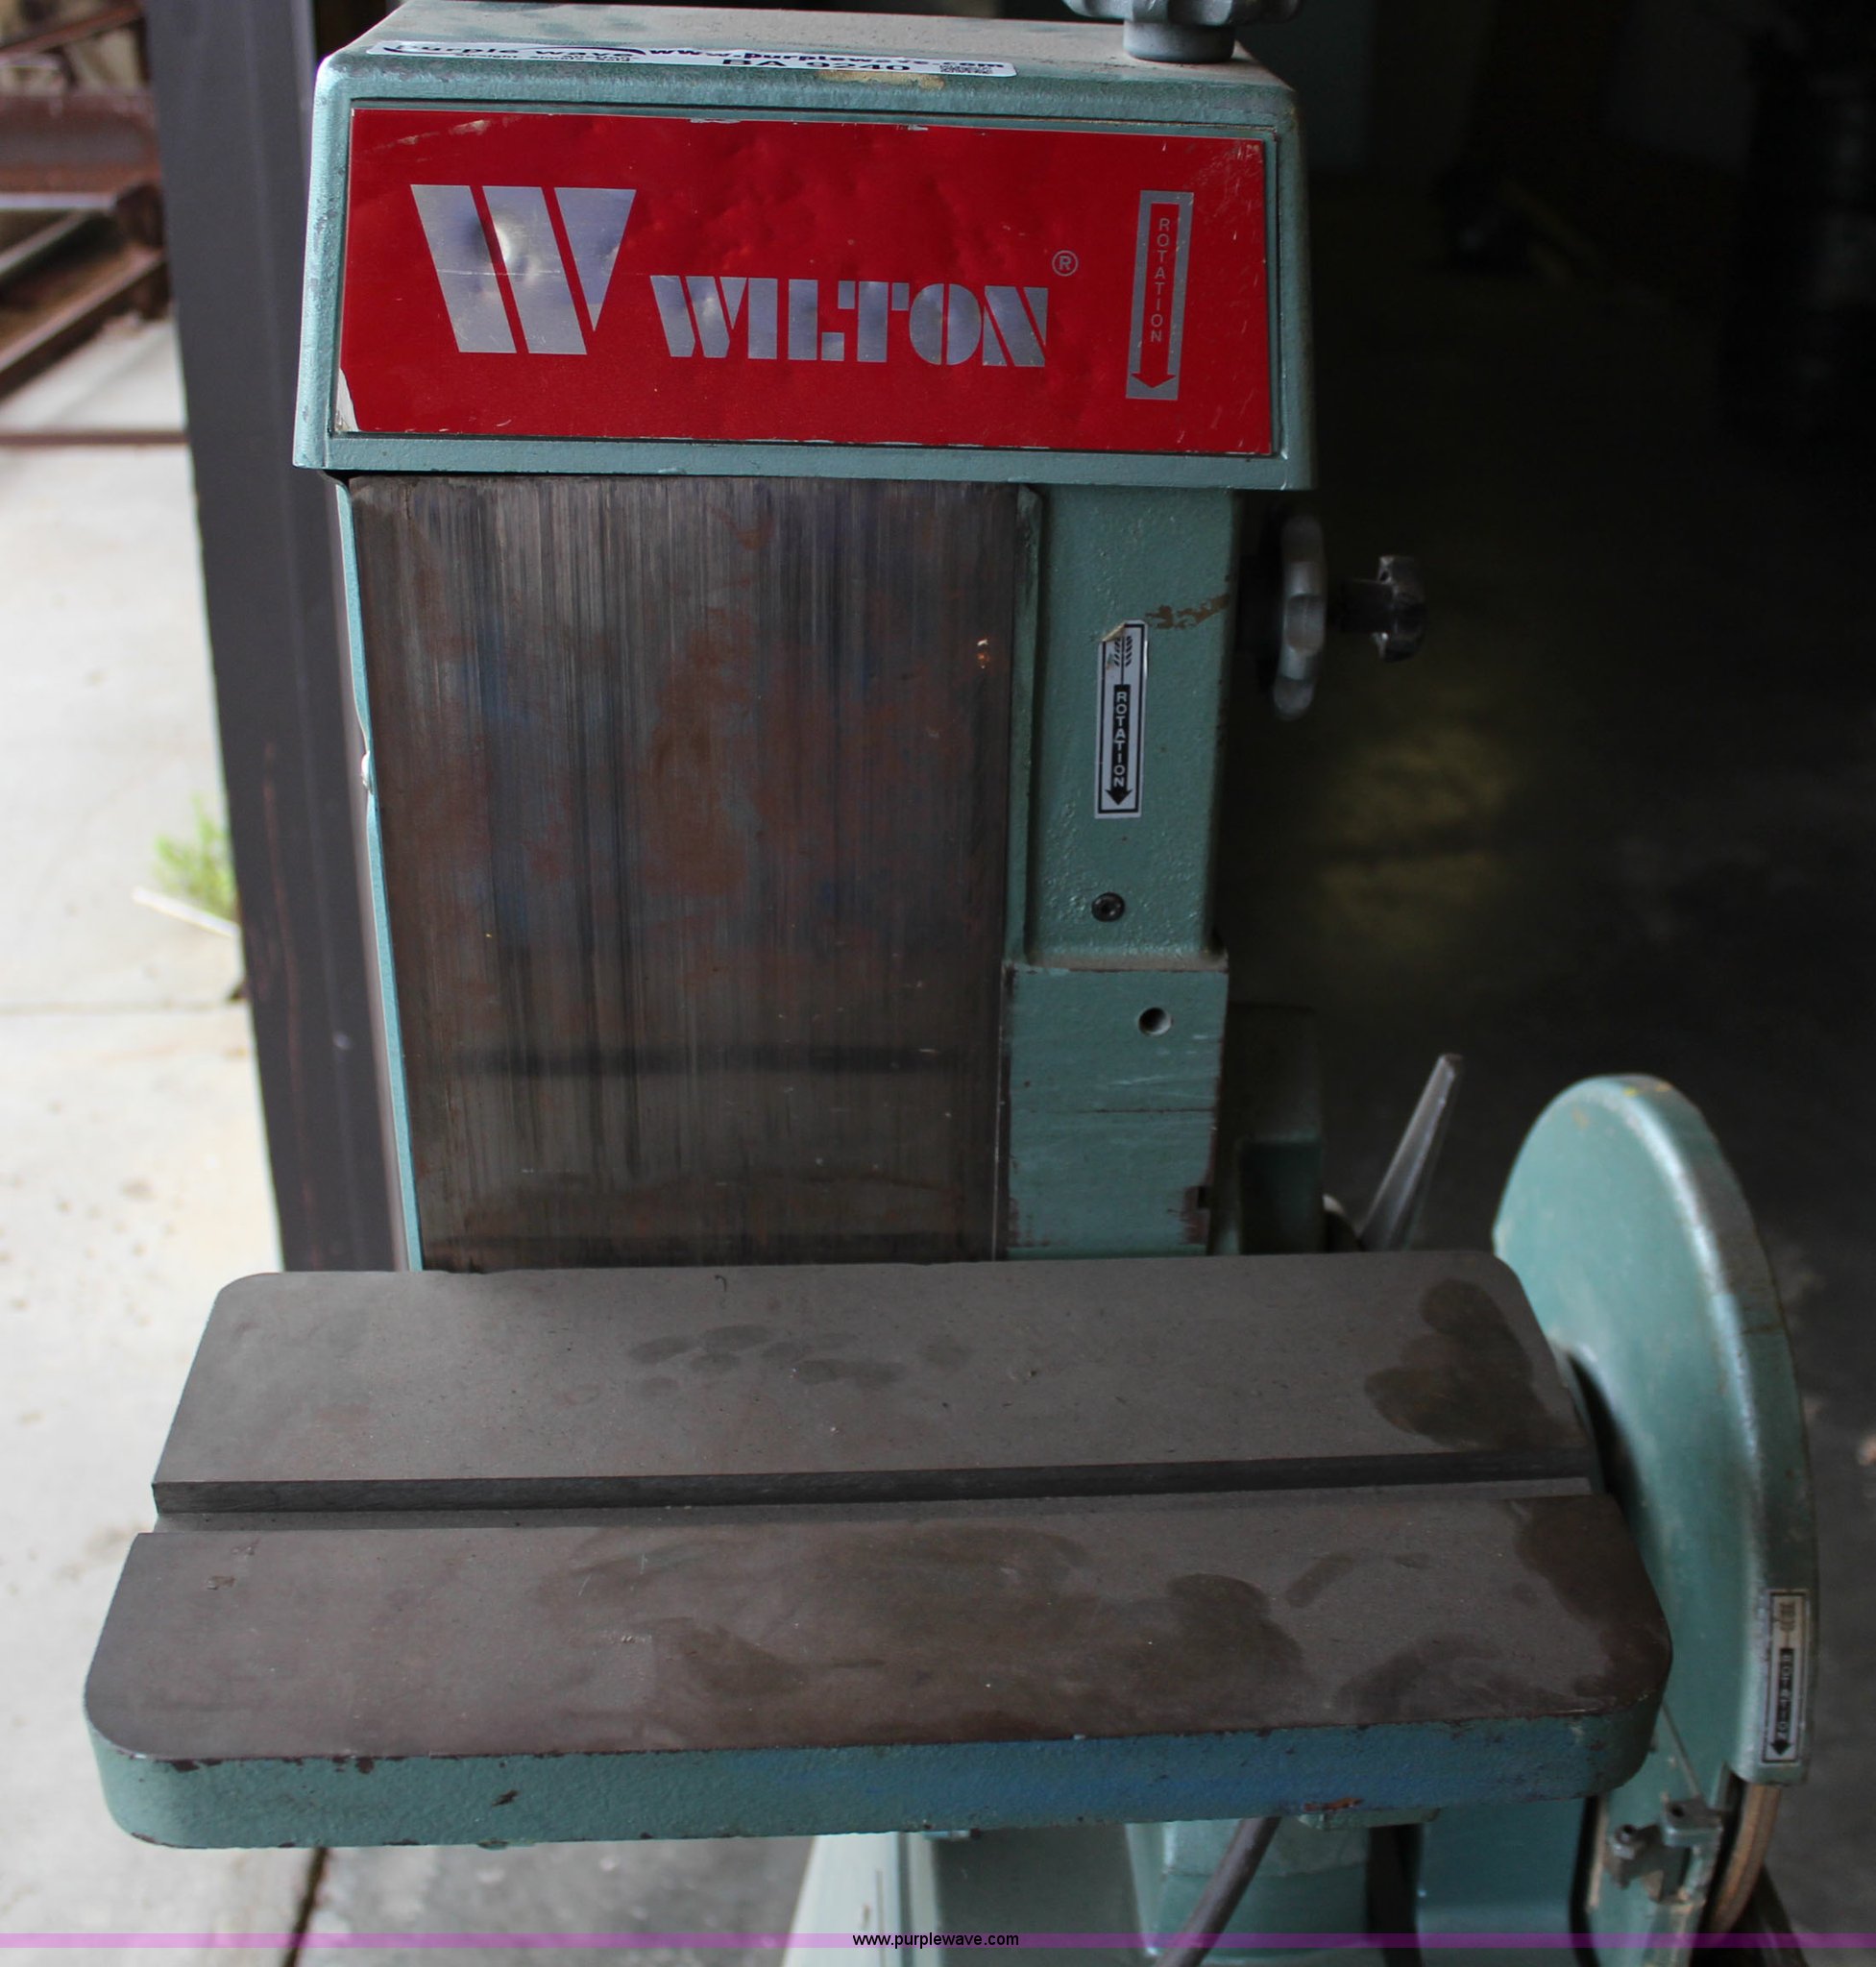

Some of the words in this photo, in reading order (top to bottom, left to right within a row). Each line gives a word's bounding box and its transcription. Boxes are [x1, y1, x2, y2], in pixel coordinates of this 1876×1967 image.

[650, 275, 1049, 369] WILTON
[1151, 217, 1171, 343] ROTATION
[1112, 691, 1128, 788] ROTATION
